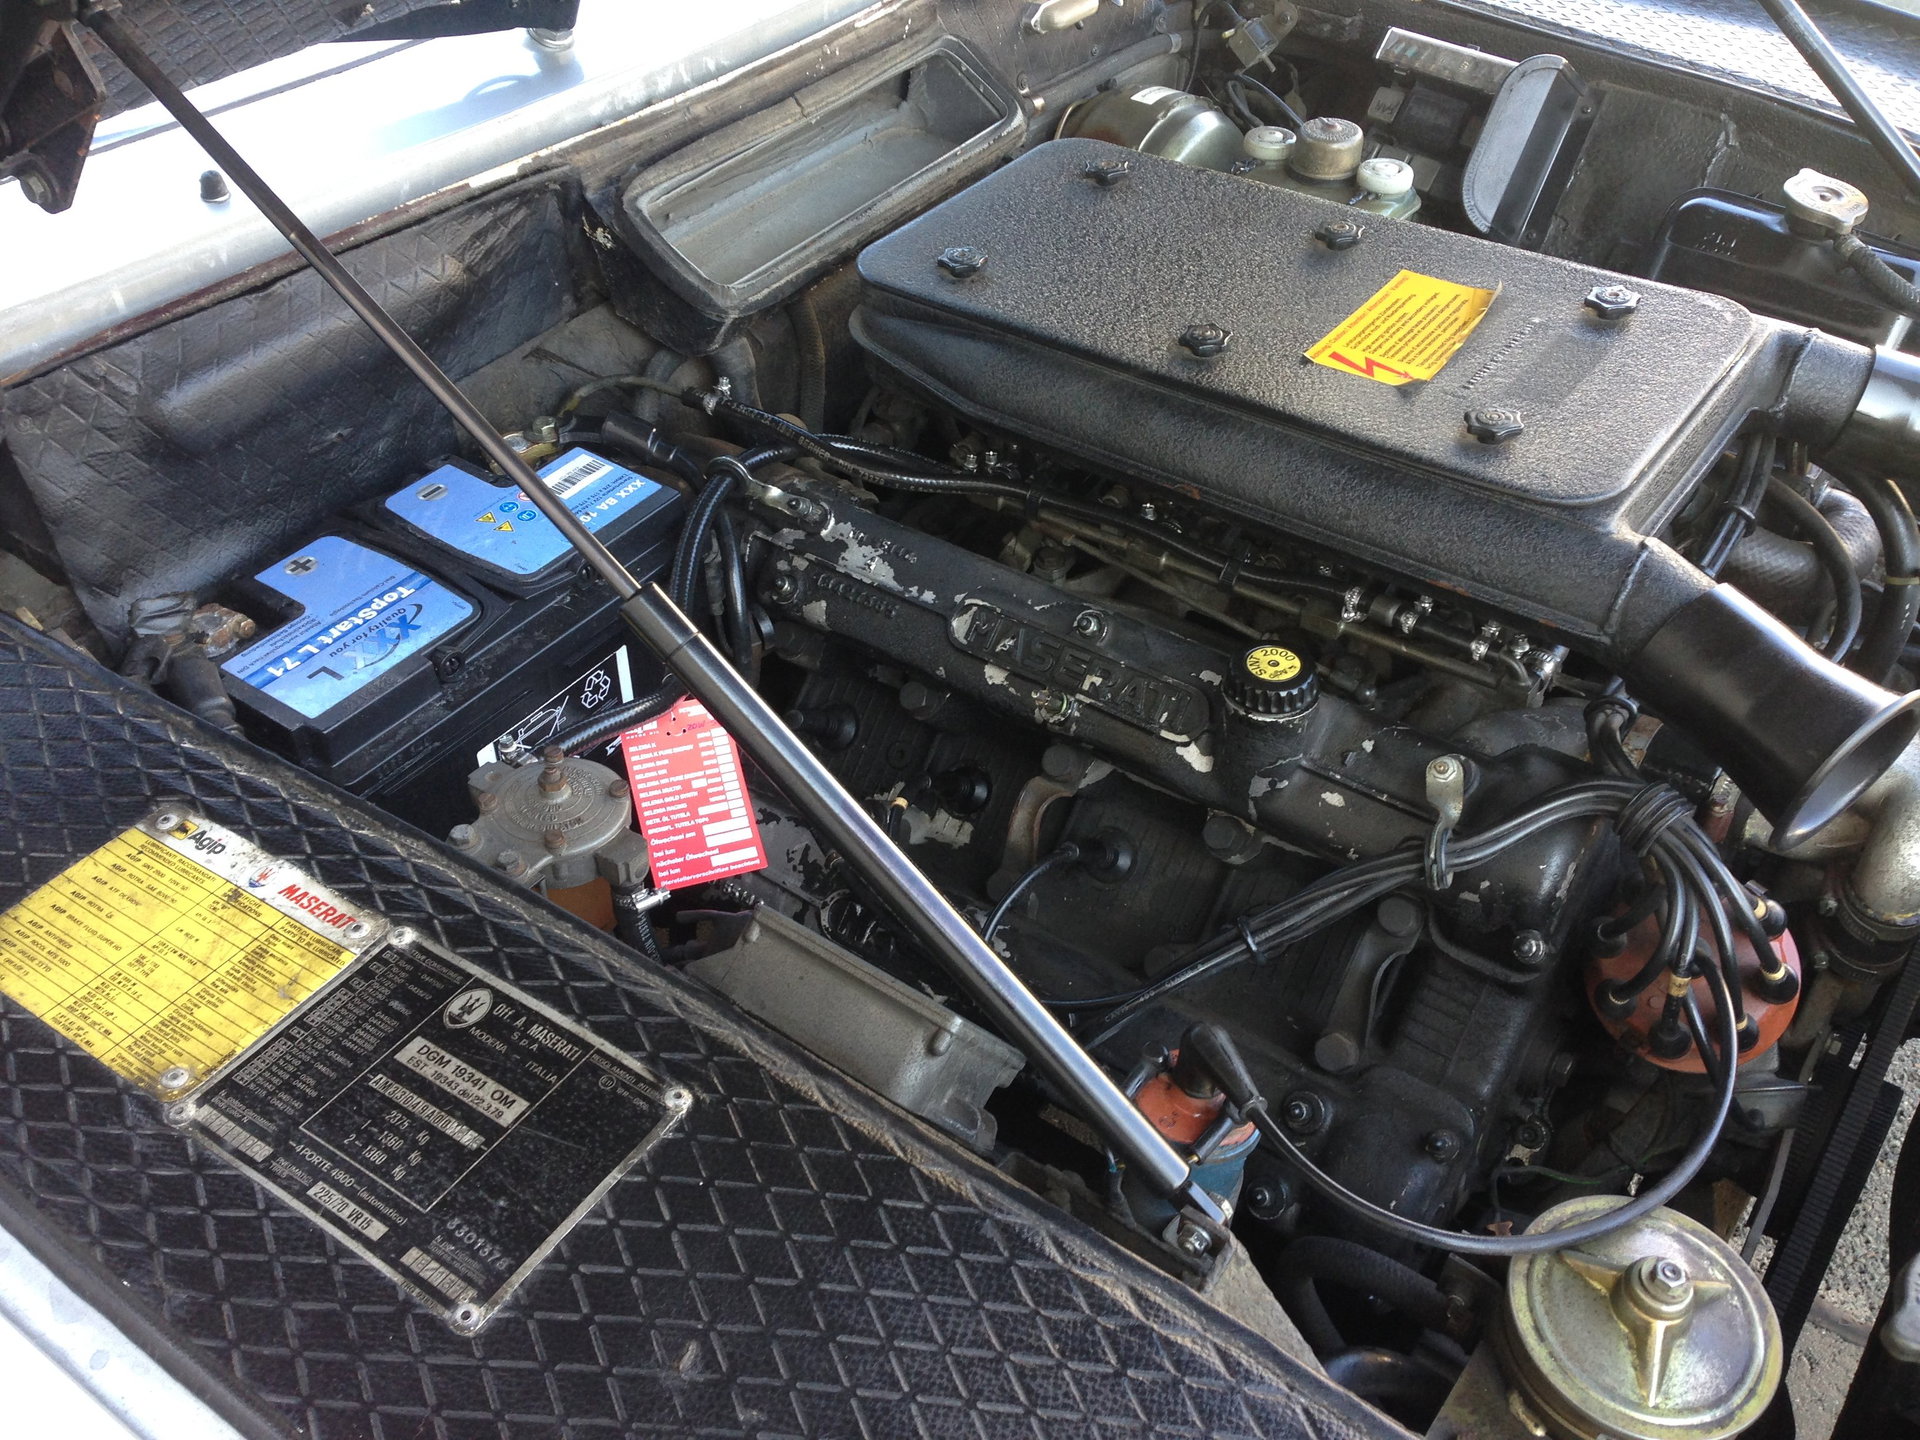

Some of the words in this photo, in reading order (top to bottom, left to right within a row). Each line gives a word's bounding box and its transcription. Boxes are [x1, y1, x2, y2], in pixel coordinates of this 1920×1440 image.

[595, 497, 618, 511] BA
[579, 510, 598, 524] 10
[317, 586, 416, 646] TopStart
[368, 607, 406, 633] Quality
[350, 632, 368, 644] for
[298, 644, 320, 658] L
[329, 641, 350, 658] you
[267, 656, 300, 677] 71
[965, 610, 1191, 733] MASERATI
[1248, 654, 1267, 676] SINT
[1260, 648, 1296, 662] 2000
[664, 794, 679, 802] GOLD
[666, 801, 688, 811] RACING
[669, 810, 690, 819] TUTELA
[674, 819, 695, 828] TUTELA
[187, 829, 226, 855] Agip
[650, 832, 684, 845] Ölwechsel
[124, 852, 142, 863] AGIP
[138, 844, 177, 866] RECOMMENDED
[684, 846, 719, 861] Ölwechsel
[110, 862, 127, 873] AGIP
[91, 875, 108, 886] AGIP
[69, 890, 87, 901] AGIP
[278, 883, 357, 930] MASERAT
[13, 928, 30, 940] AGIP
[26, 919, 44, 930] AGIP
[42, 929, 73, 949] ANTIFREEZE
[49, 903, 67, 915] AGIP
[64, 914, 83, 926] BRAKE
[81, 924, 98, 936] FLUID
[95, 933, 115, 946] SUPER
[0, 937, 17, 949] AGIP
[15, 948, 37, 962] GREASE
[2, 957, 24, 972] GREASE
[490, 1002, 519, 1022] Off.
[512, 1015, 532, 1030] A.
[524, 1022, 584, 1061] MASERATI
[466, 1026, 510, 1053] MODENA
[523, 1060, 559, 1084] ITALIA
[415, 1044, 453, 1069] DGM
[448, 1063, 488, 1091] 19341
[487, 1087, 517, 1109] OM
[429, 1069, 461, 1091] 19343
[456, 1086, 474, 1099] del
[468, 1095, 505, 1120] 22.3.79
[384, 1109, 412, 1130] 2375
[412, 1129, 433, 1146] Kg
[376, 1130, 404, 1151] 1360
[404, 1149, 425, 1167] Kg
[360, 1144, 388, 1165] 1360
[387, 1163, 409, 1181] Kg
[312, 1185, 349, 1214] 225/70
[327, 1166, 356, 1188] 4900
[355, 1185, 410, 1227] (automatico)
